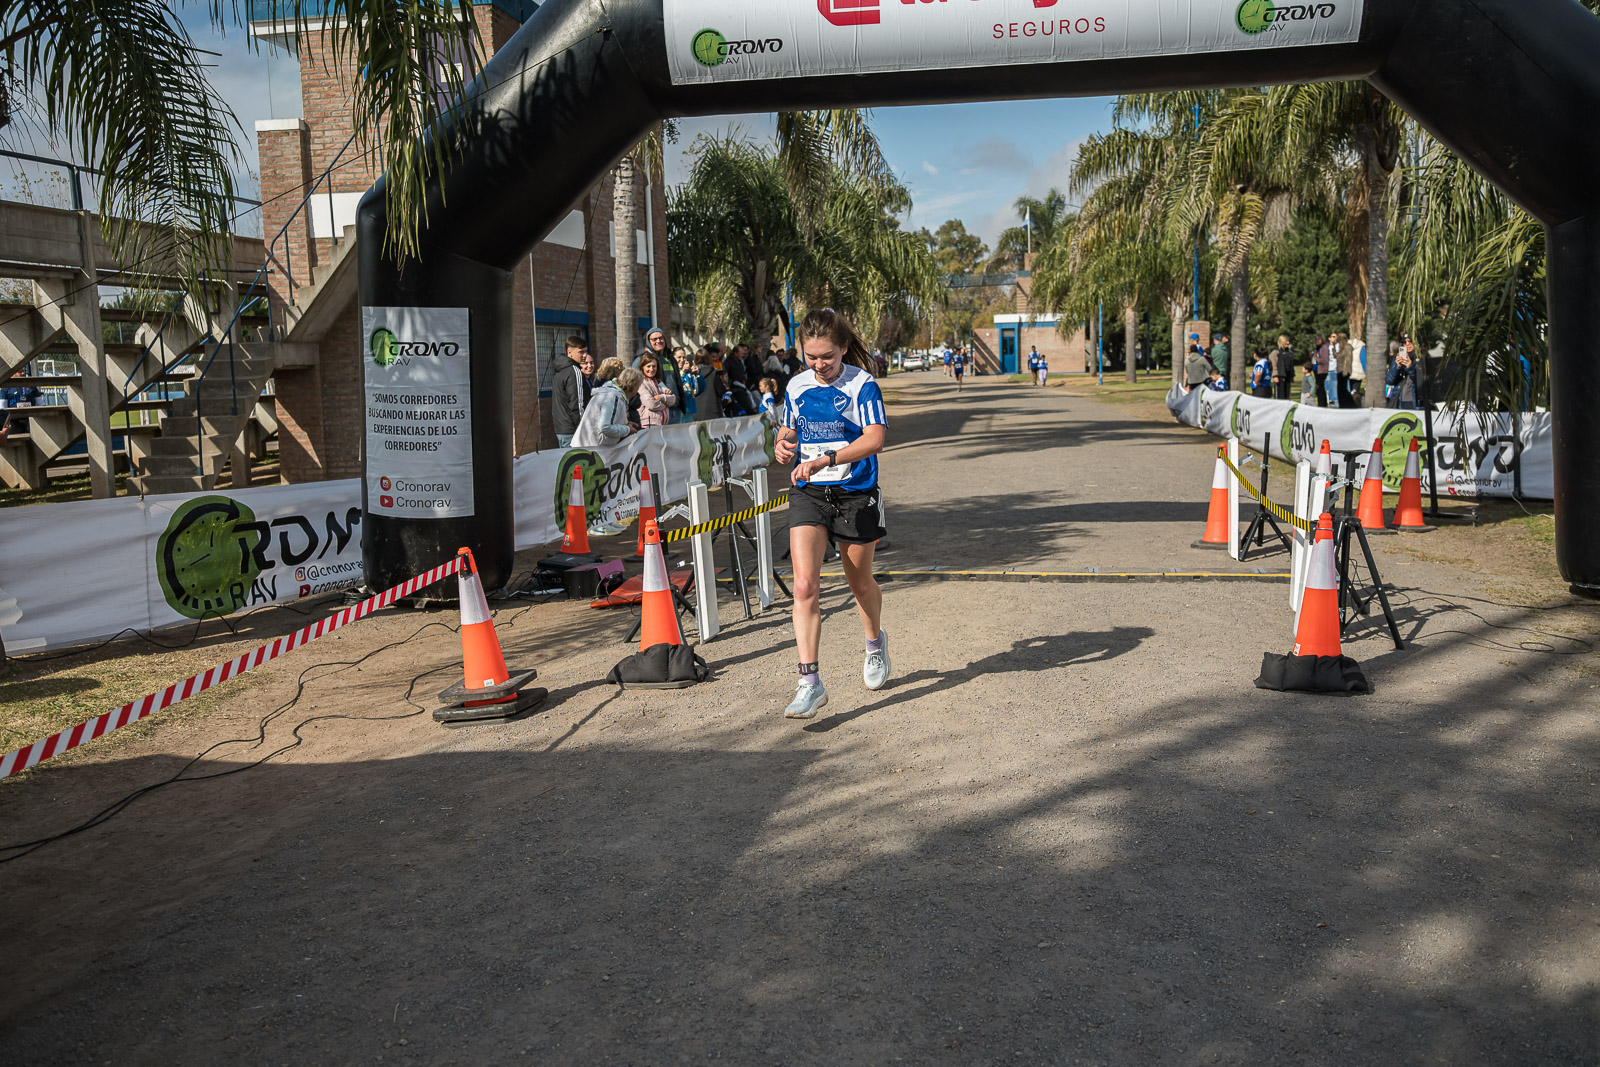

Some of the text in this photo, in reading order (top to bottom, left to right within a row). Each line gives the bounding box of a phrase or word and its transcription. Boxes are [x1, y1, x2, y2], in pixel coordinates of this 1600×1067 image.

[1262, 3, 1335, 23] CRONO
[992, 17, 1106, 39] SEGUROS
[1260, 23, 1286, 33] RAV
[717, 38, 783, 56] CRONO
[717, 57, 741, 66] RAV
[389, 341, 460, 356] CRONO
[388, 358, 411, 366] RAV
[400, 394, 458, 405] CORREDORES
[369, 407, 466, 421] BUSCANDO MEJORAR LAS
[373, 423, 458, 436] EXPERIENCIAS DE LOS
[797, 415, 811, 442] 3
[395, 480, 451, 492] Cronorav
[396, 496, 452, 508] Cronorav
[229, 574, 278, 610] RAV
